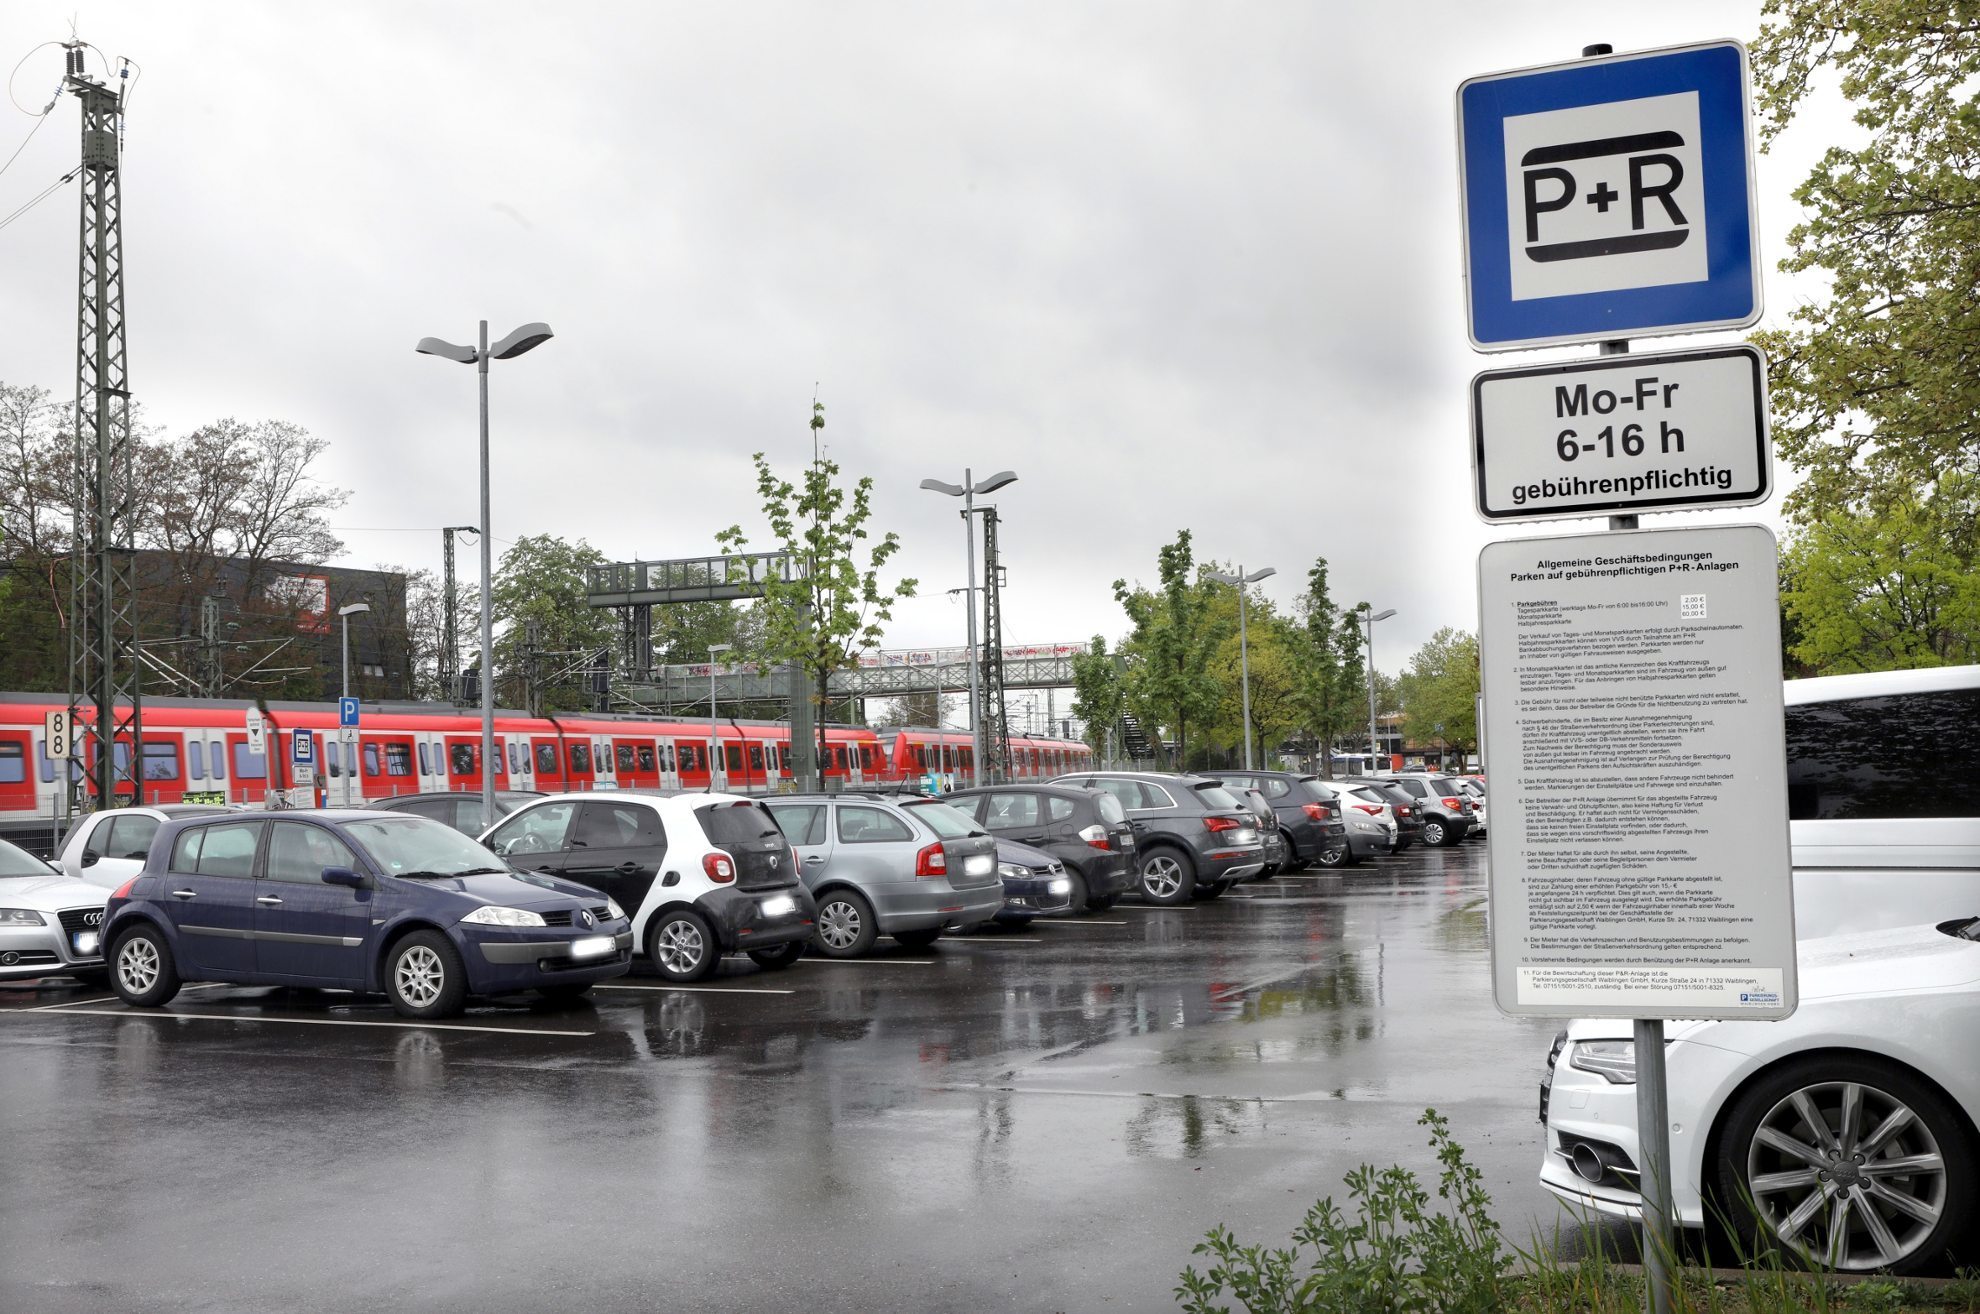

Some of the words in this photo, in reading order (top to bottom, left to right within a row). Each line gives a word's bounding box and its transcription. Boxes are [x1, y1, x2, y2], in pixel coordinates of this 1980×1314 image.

[1523, 153, 1688, 242] P+R
[1555, 377, 1679, 418] Mo-Fr
[1556, 423, 1645, 461] 6-16
[1661, 421, 1685, 454] h
[1512, 466, 1733, 504] gebührenpflichtig
[1537, 557, 1592, 568] Allgemeine
[1594, 551, 1712, 565] Geschäftsbedingungen
[1510, 571, 1544, 580] Parken
[1565, 565, 1666, 578] gebührenpflichtigen
[344, 701, 354, 722] P
[54, 714, 62, 732] 8
[54, 736, 62, 754] 8
